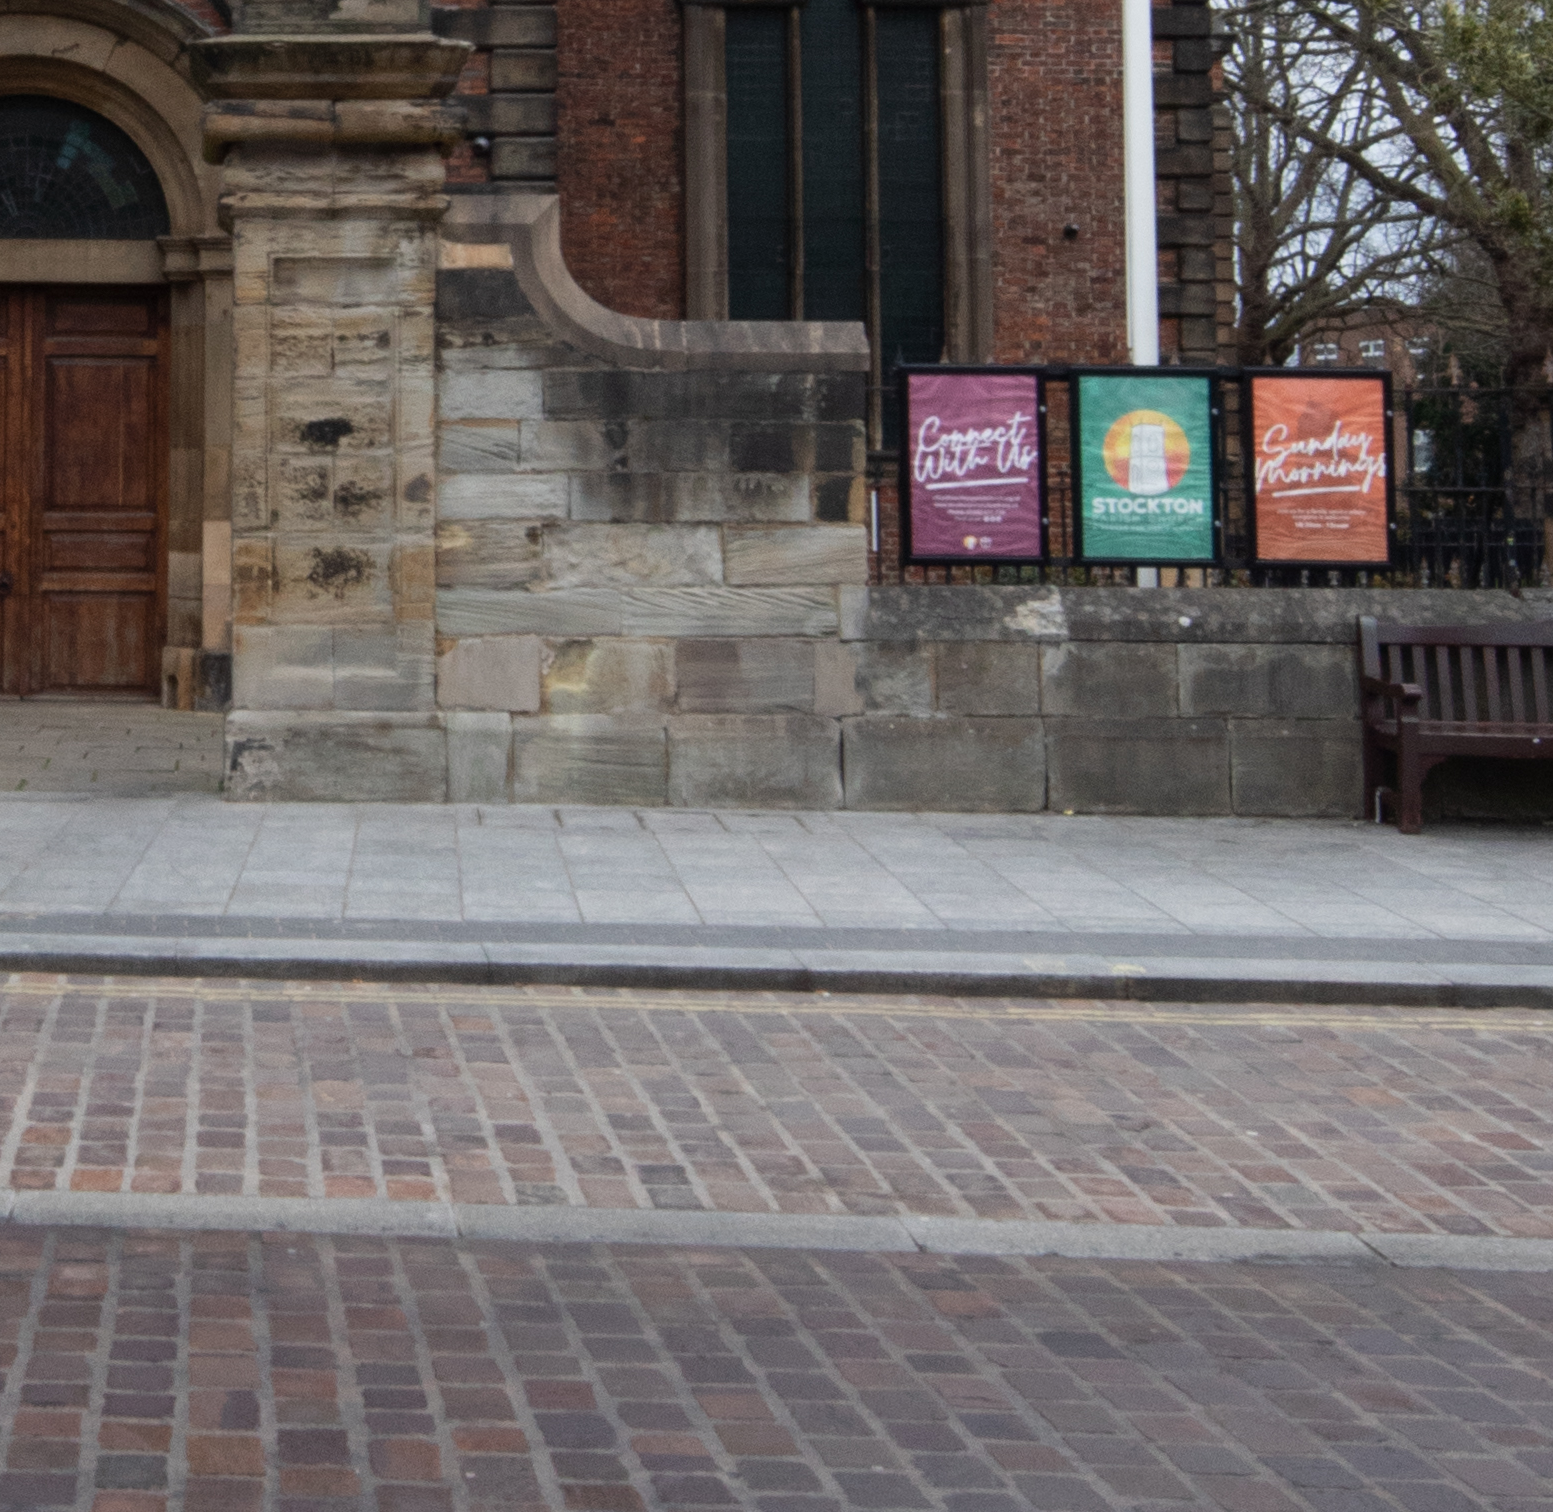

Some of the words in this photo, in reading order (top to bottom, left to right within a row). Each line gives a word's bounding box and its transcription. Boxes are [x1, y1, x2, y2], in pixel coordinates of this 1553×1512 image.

[918, 411, 1032, 451] Connect
[1262, 420, 1373, 467] Sunday
[914, 440, 988, 482] With
[997, 441, 1038, 473] Us
[1254, 452, 1387, 494] Mornings
[1092, 497, 1204, 514] STOCKTON
